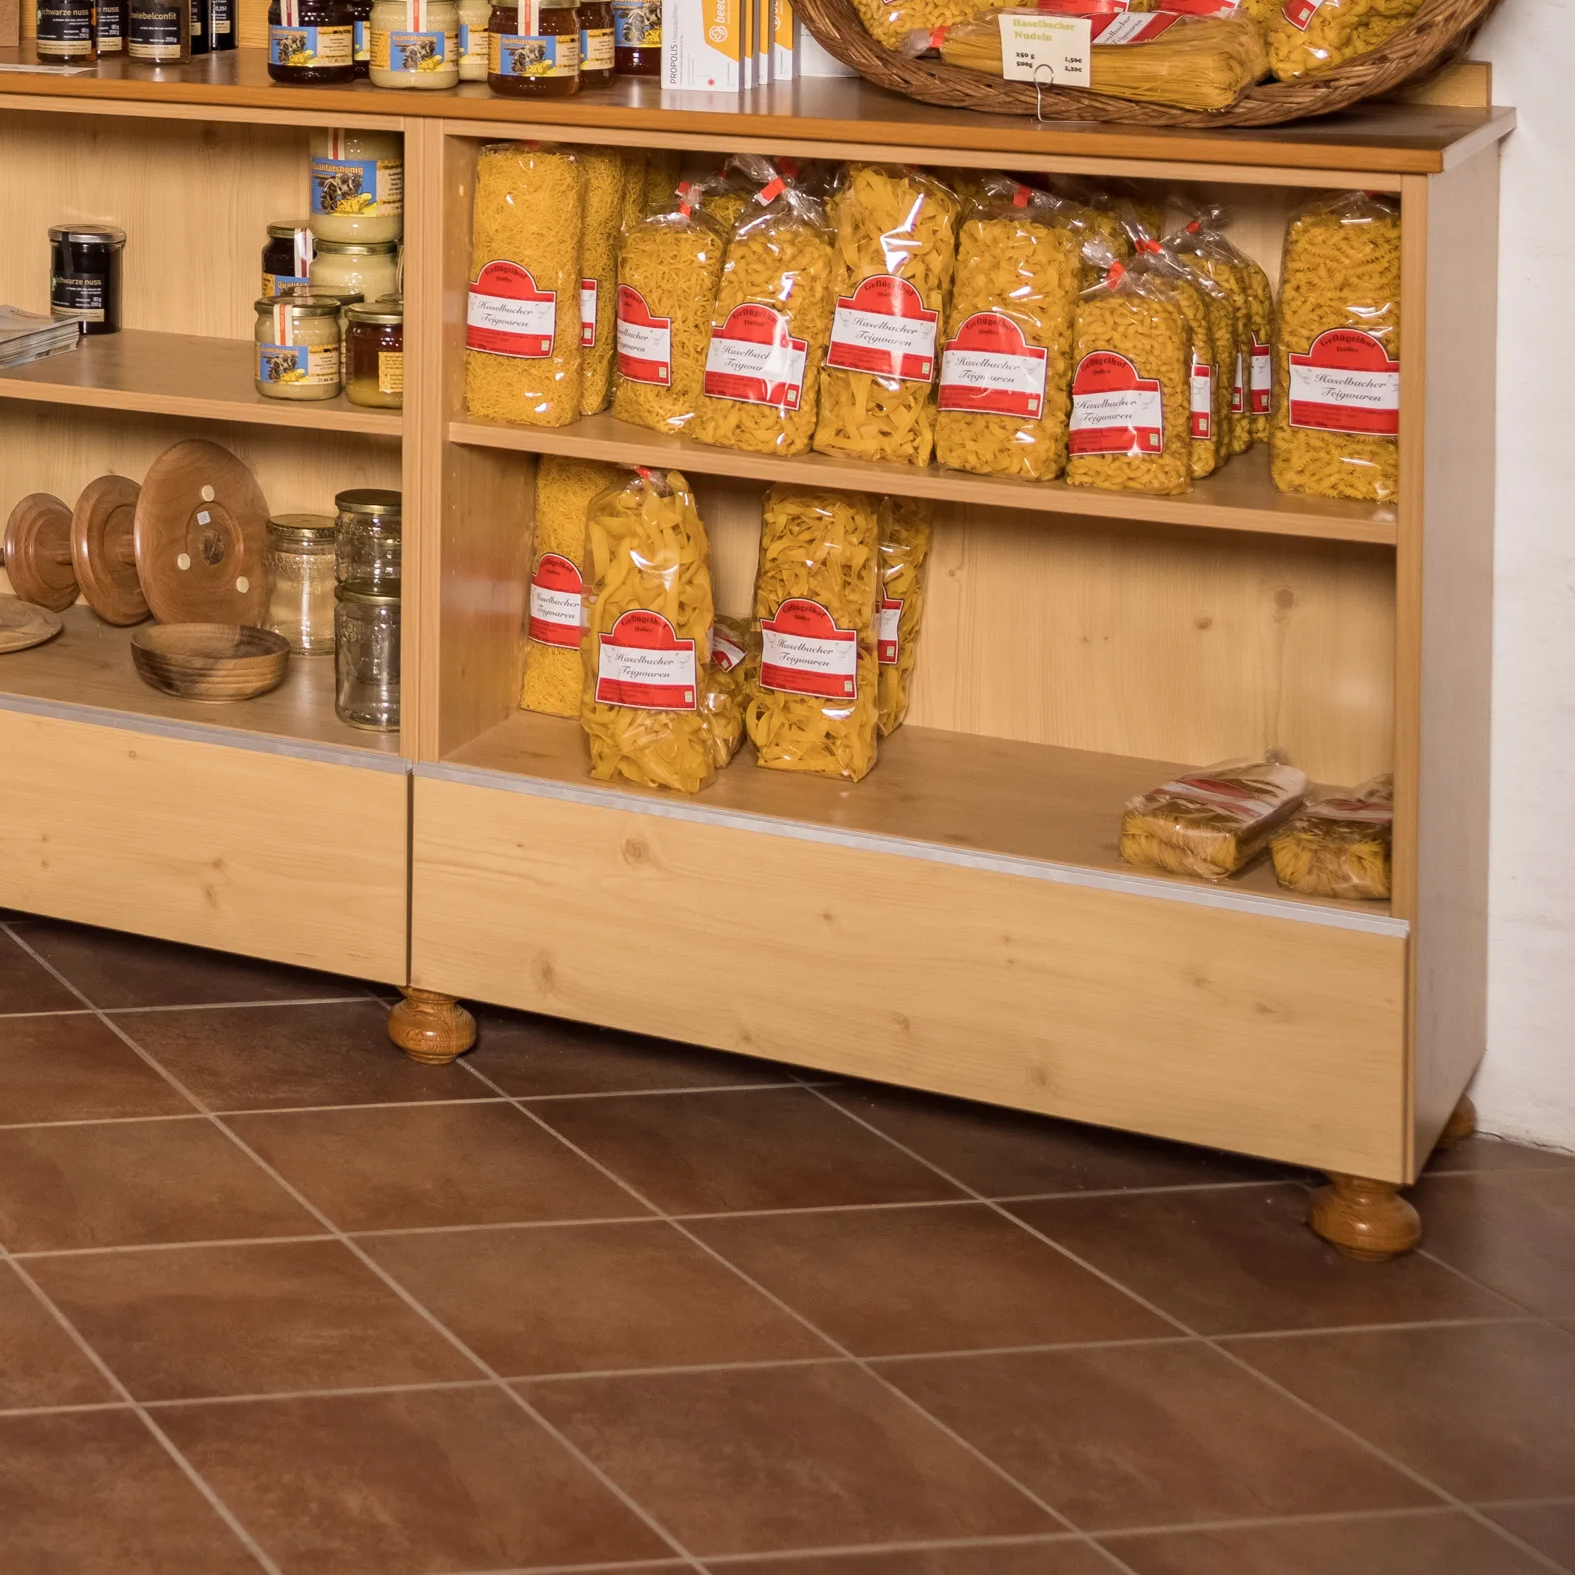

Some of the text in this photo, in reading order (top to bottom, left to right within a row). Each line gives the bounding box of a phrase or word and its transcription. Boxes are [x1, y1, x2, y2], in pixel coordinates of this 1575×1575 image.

[1012, 18, 1076, 31] Haselbacher
[1014, 31, 1052, 41] Nudeln
[670, 44, 678, 84] PROPOLIS
[1016, 61, 1033, 69] 500g
